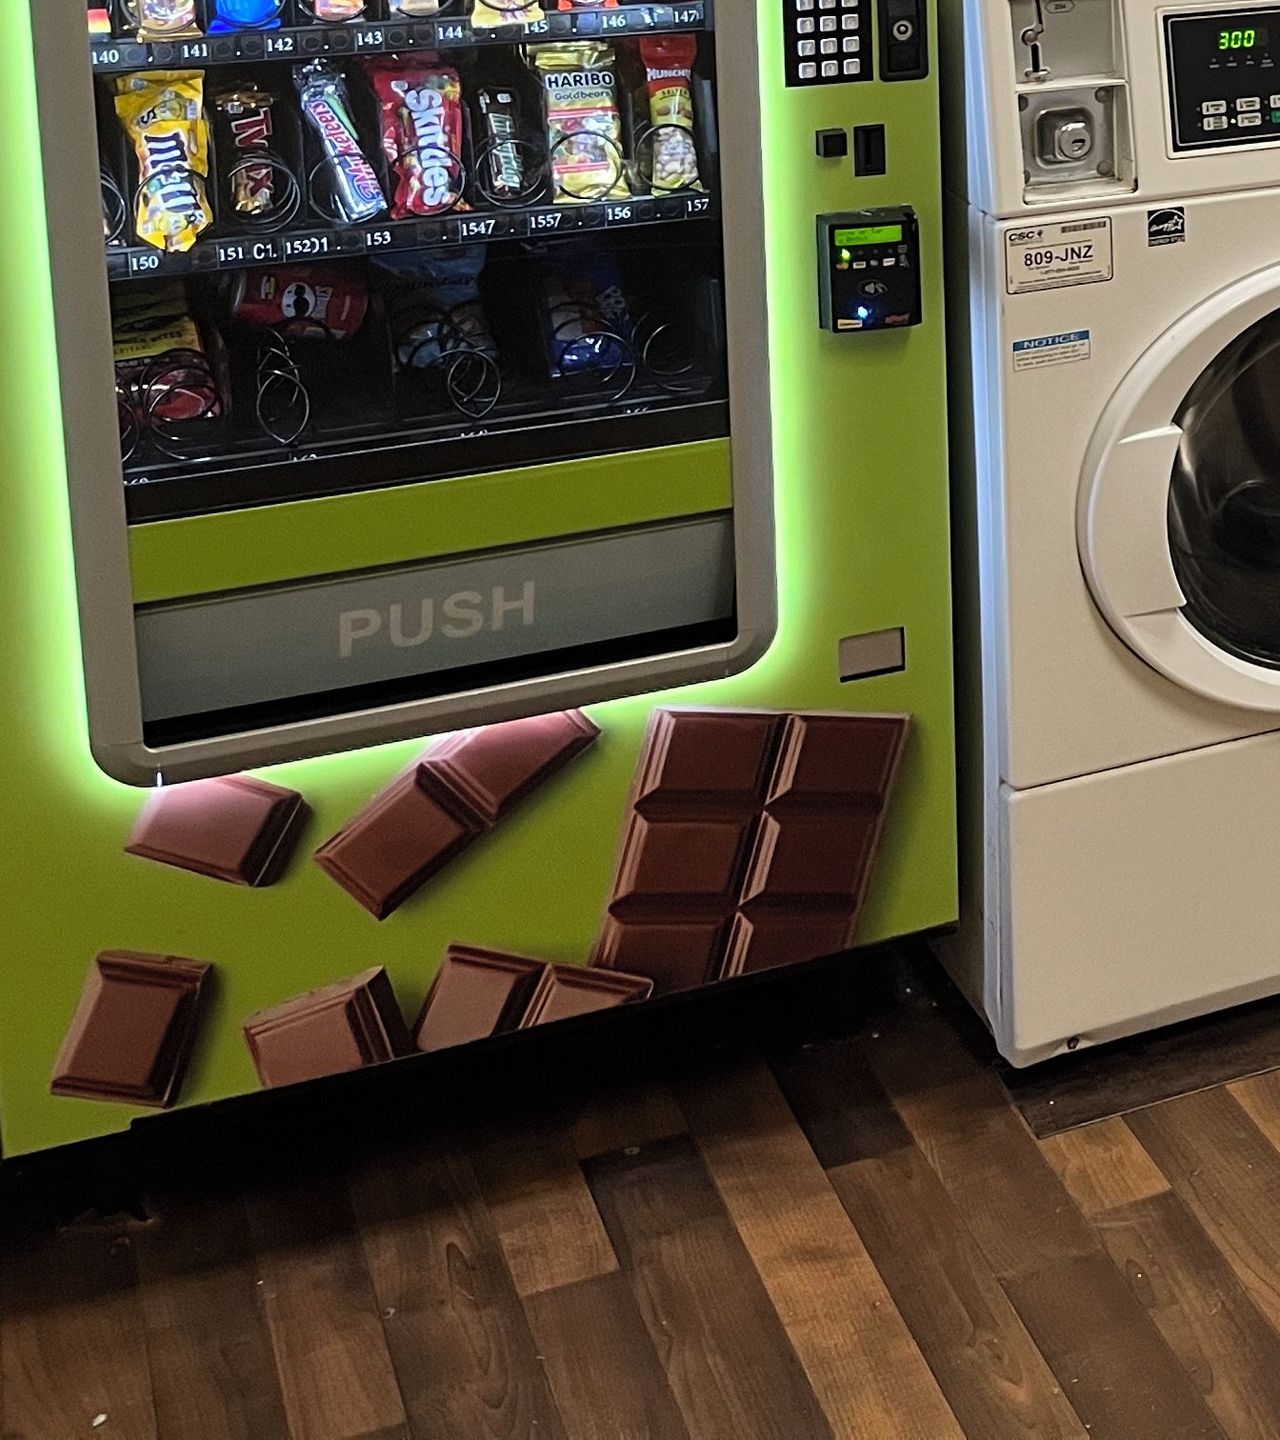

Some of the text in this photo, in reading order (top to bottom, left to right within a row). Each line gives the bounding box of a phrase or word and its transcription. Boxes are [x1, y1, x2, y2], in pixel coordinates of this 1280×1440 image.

[601, 13, 627, 28] 146
[673, 8, 696, 23] 147
[437, 25, 463, 40] 144
[523, 19, 549, 35] 145
[266, 37, 293, 52] 142
[356, 31, 383, 46] 143
[1218, 30, 1256, 51] 300
[91, 48, 120, 64] 140
[182, 43, 208, 59] 141
[547, 72, 614, 89] HARIBO
[554, 90, 612, 101] Goldbears
[404, 87, 450, 208] Skittles
[607, 206, 631, 221] 156
[686, 198, 709, 213] 157
[366, 232, 392, 246] 153
[1008, 230, 1035, 242] CSC
[219, 245, 244, 261] 151
[1024, 244, 1094, 268] 809-JNZ
[131, 255, 160, 271] 150
[1022, 332, 1080, 349] NOTICE
[336, 581, 536, 658] PUSH
